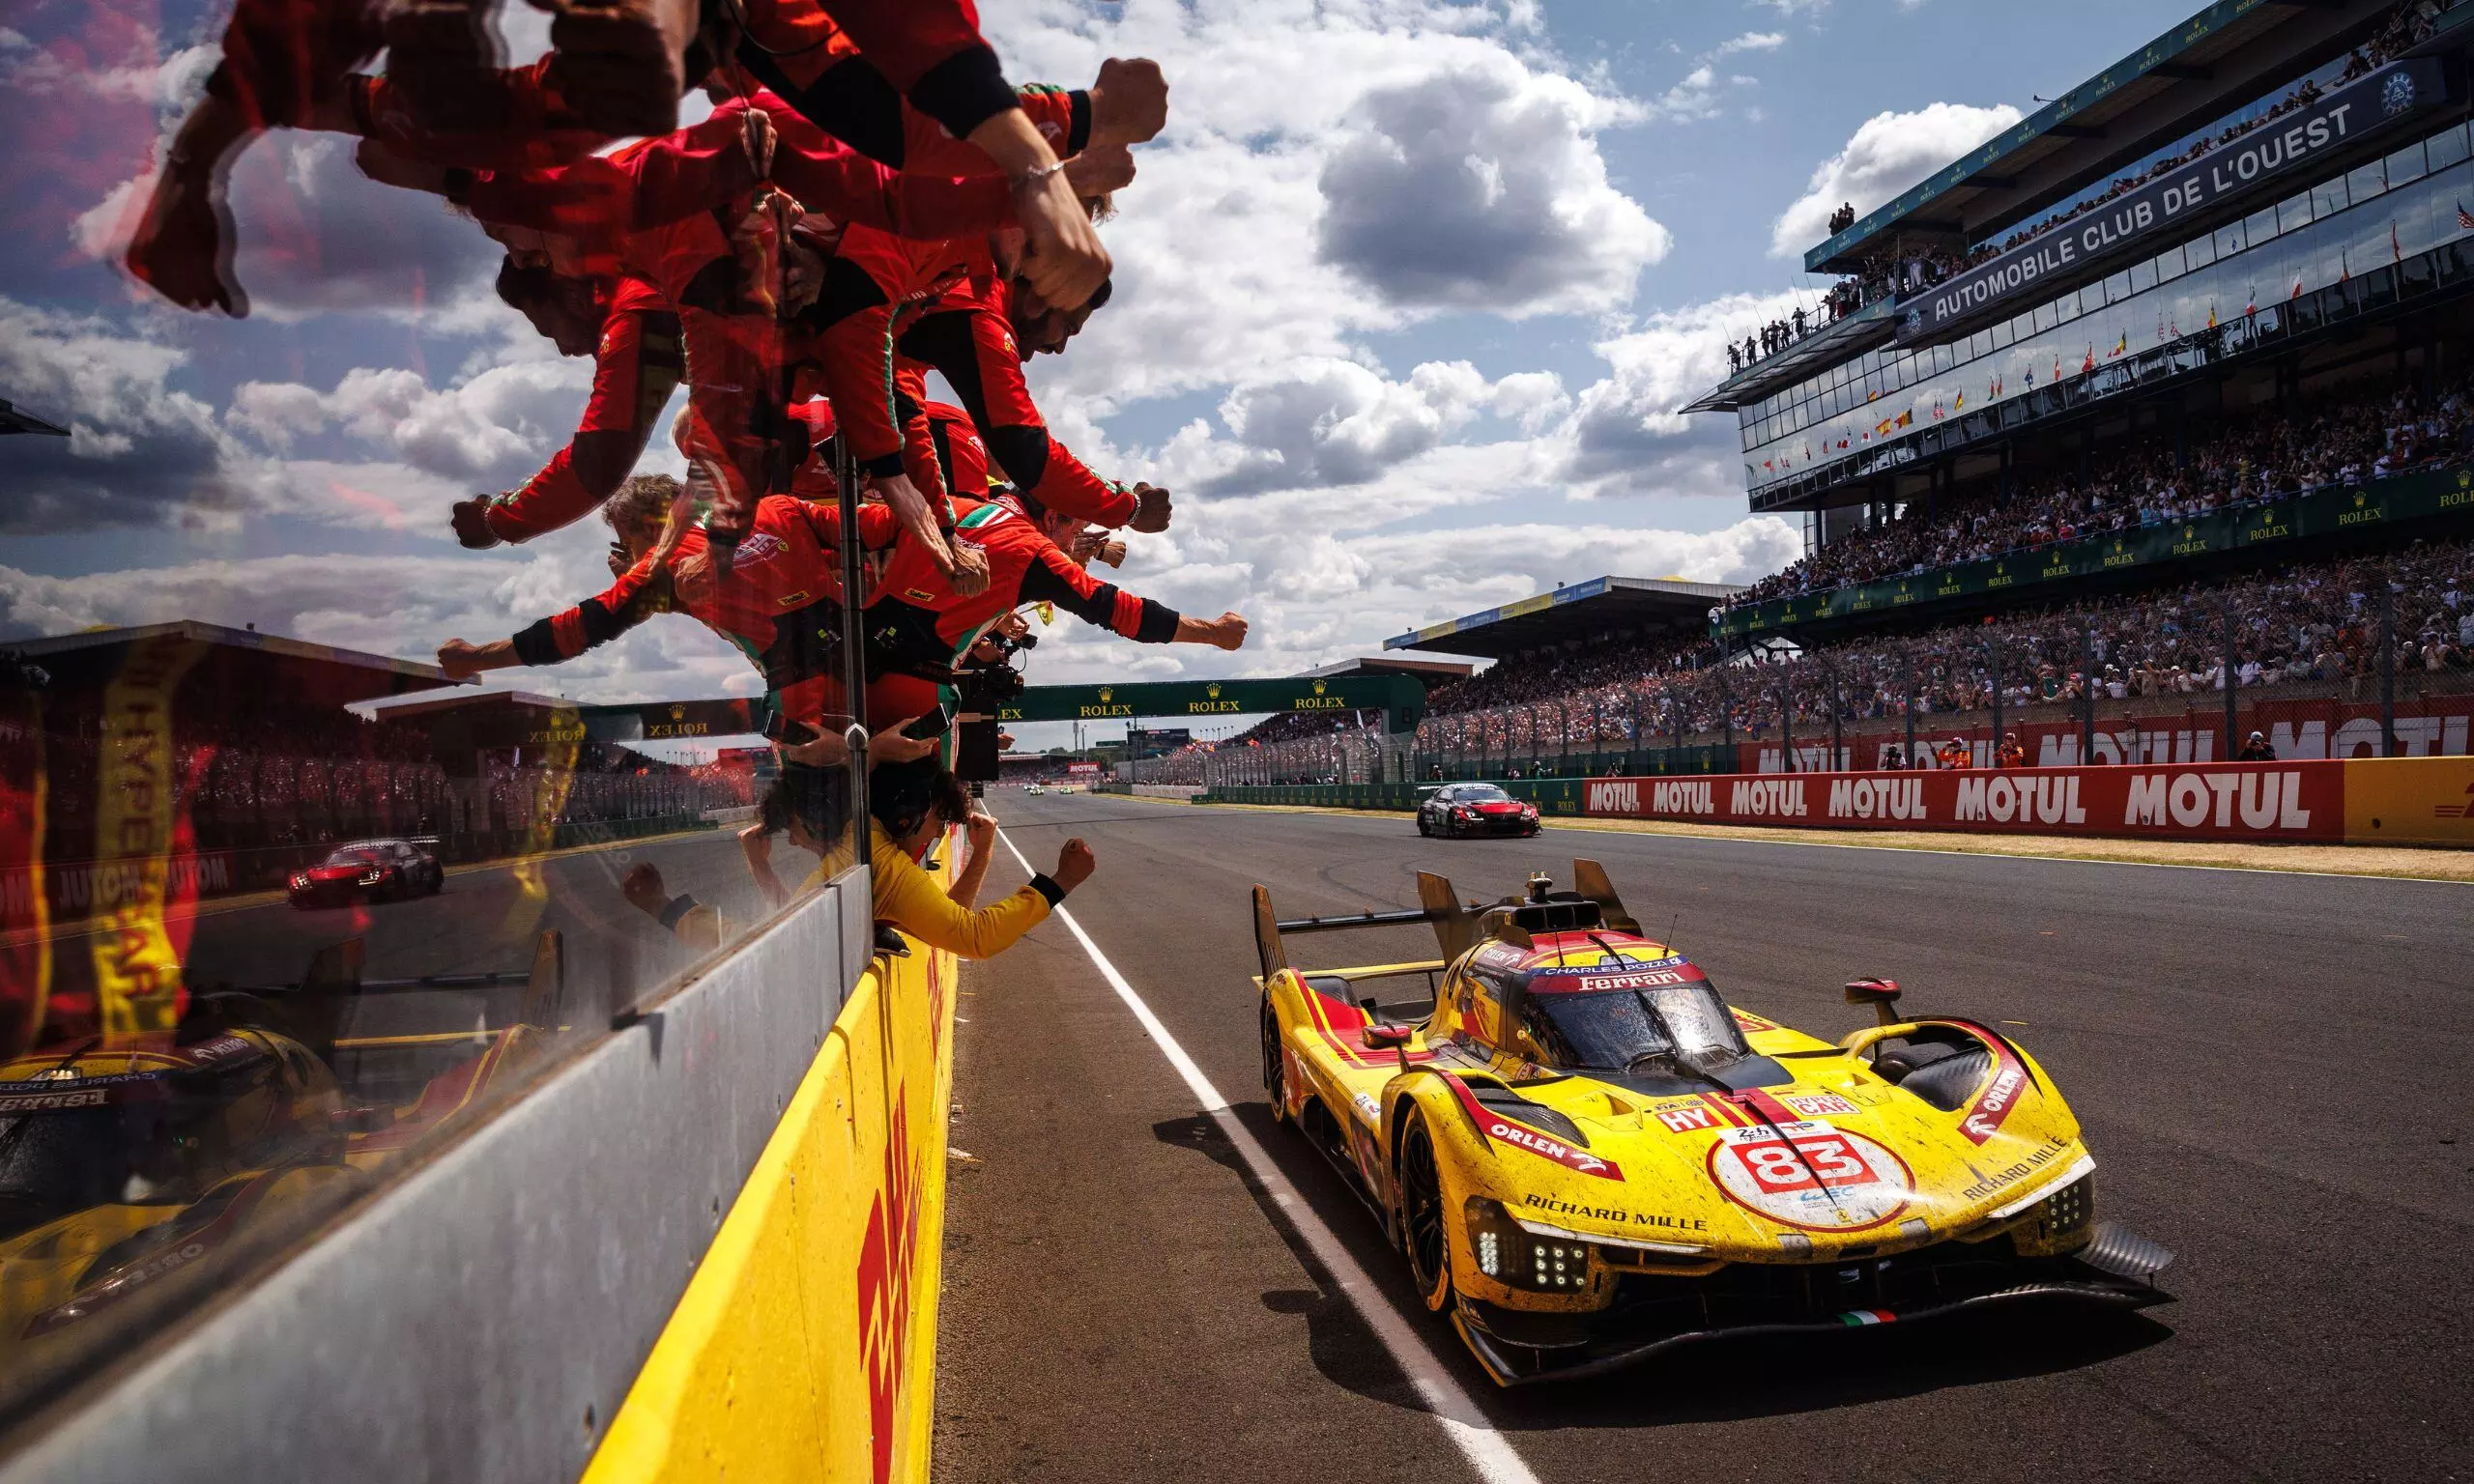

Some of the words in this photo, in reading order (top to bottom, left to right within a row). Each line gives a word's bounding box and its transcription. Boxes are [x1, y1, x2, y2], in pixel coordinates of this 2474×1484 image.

[2185, 24, 2208, 43] ROLEX
[2139, 54, 2160, 71] ROLEX
[2095, 80, 2115, 97] ROLEX
[2056, 104, 2074, 121] ROLEX
[2018, 128, 2035, 143] ROLEX
[1935, 237, 2076, 322] AUTOMOBILE
[2083, 200, 2154, 252] CLUB
[2163, 176, 2202, 215] DE
[2213, 103, 2351, 193] L'OUEST
[2339, 507, 2382, 526] ROLEX
[2250, 525, 2288, 541] ROLEX
[2172, 539, 2206, 556] ROLEX
[2104, 553, 2134, 567] ROLEX
[2042, 564, 2070, 578] ROLEX
[1988, 575, 2012, 587] ROLEX
[1893, 593, 1914, 604] ROLEX
[1939, 585, 1961, 596] ROLEX
[1853, 601, 1871, 611] ROLEX
[1080, 704, 1133, 717] ROLEX
[1189, 700, 1240, 713] ROLEX
[1295, 697, 1345, 709] ROLEX
[1070, 764, 1098, 773] MOTUL
[1557, 800, 1576, 812] ROLEX
[1590, 783, 1640, 813] MOTUL
[1654, 782, 1713, 814] MOTUL
[1731, 780, 1807, 816] MOTUL
[1829, 778, 1927, 820] MOTUL
[1954, 776, 2086, 824] MOTUL
[2125, 773, 2311, 829] MOTUL
[1483, 948, 1507, 962] ORLEN
[1545, 964, 1623, 976] CHARLES
[1625, 959, 1667, 971] POZZI
[1579, 970, 1685, 992] Ferrari
[1984, 1068, 2025, 1112] ORLEN
[1789, 1096, 1844, 1105] HYPER
[1797, 1101, 1856, 1115] CAR
[1658, 1107, 1712, 1132] HY
[1490, 1123, 1567, 1157] ORLEN
[1746, 1140, 1864, 1185] 83
[1962, 1161, 2030, 1202] RICHARD
[2028, 1134, 2067, 1166] MILLE
[1525, 1192, 1626, 1223] RICHARD
[1635, 1213, 1708, 1232] MILLE
